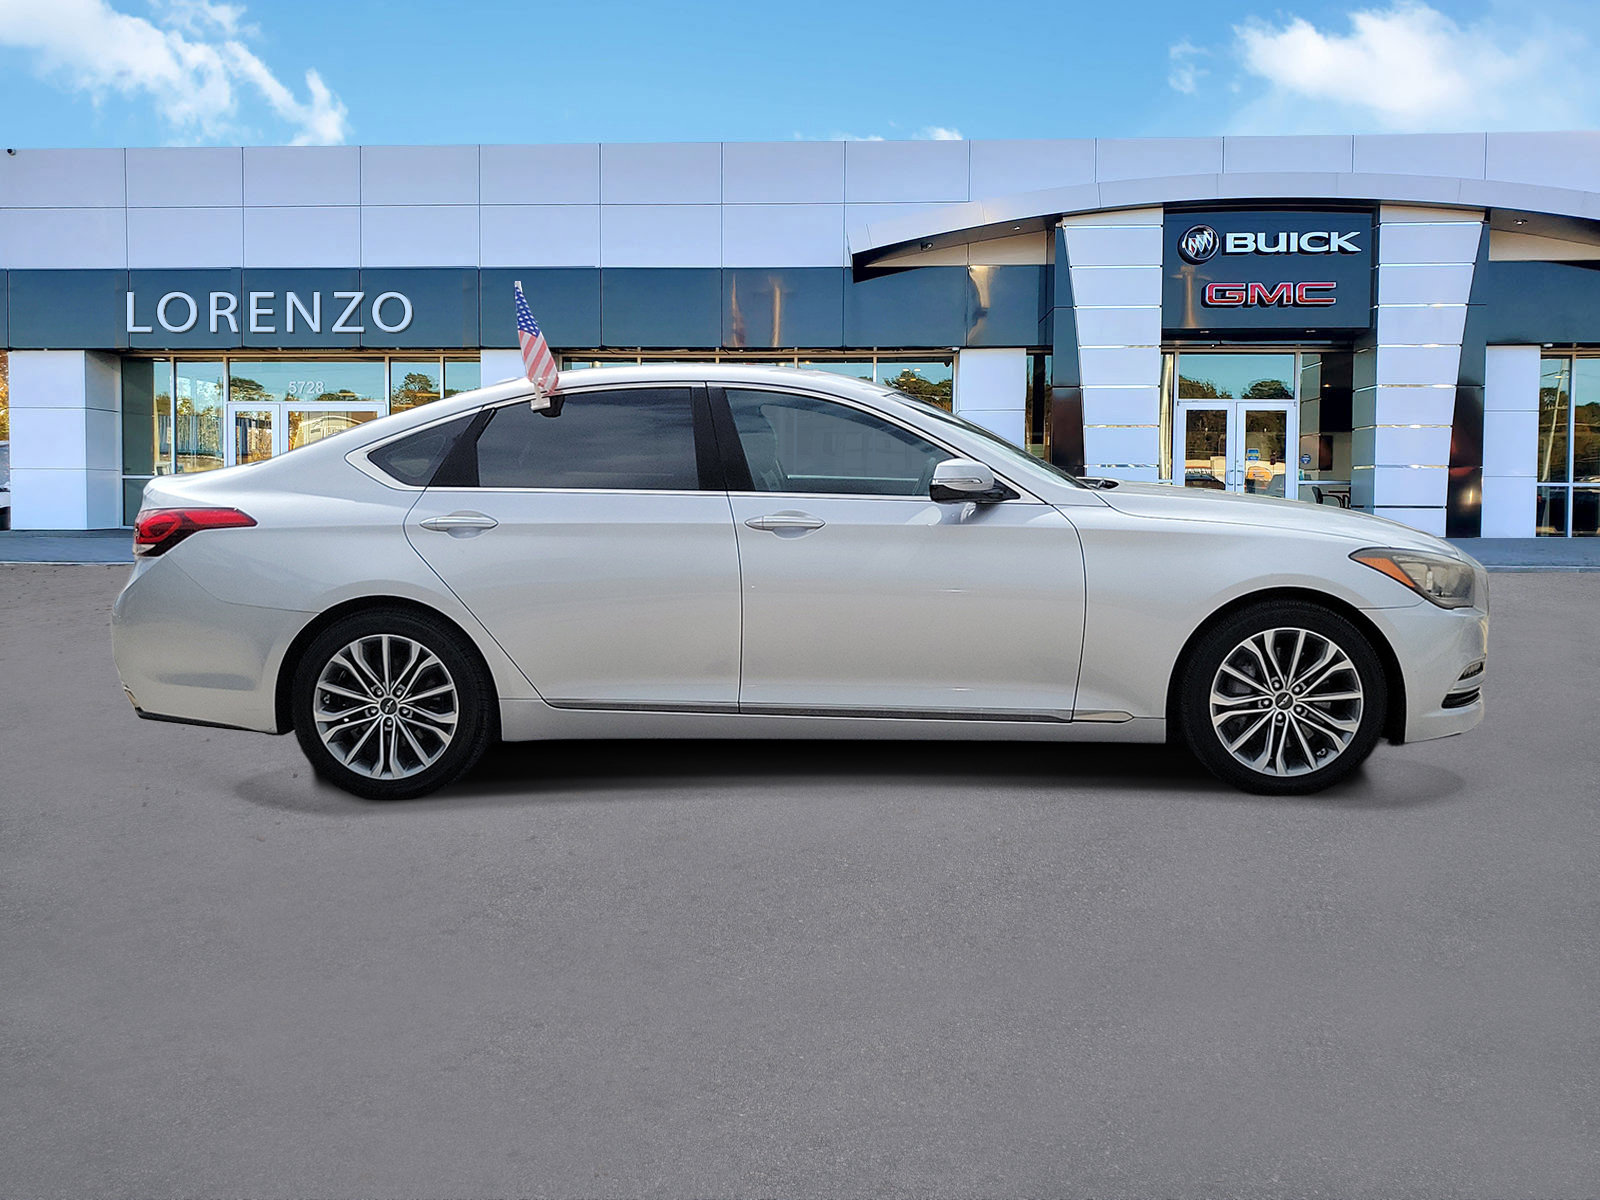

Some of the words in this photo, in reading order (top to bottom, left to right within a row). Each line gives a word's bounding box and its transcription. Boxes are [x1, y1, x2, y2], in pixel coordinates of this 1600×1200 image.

[1225, 231, 1362, 253] BUICK
[1205, 282, 1337, 305] GMC
[126, 291, 413, 333] LORENZO
[288, 381, 325, 394] 5728
